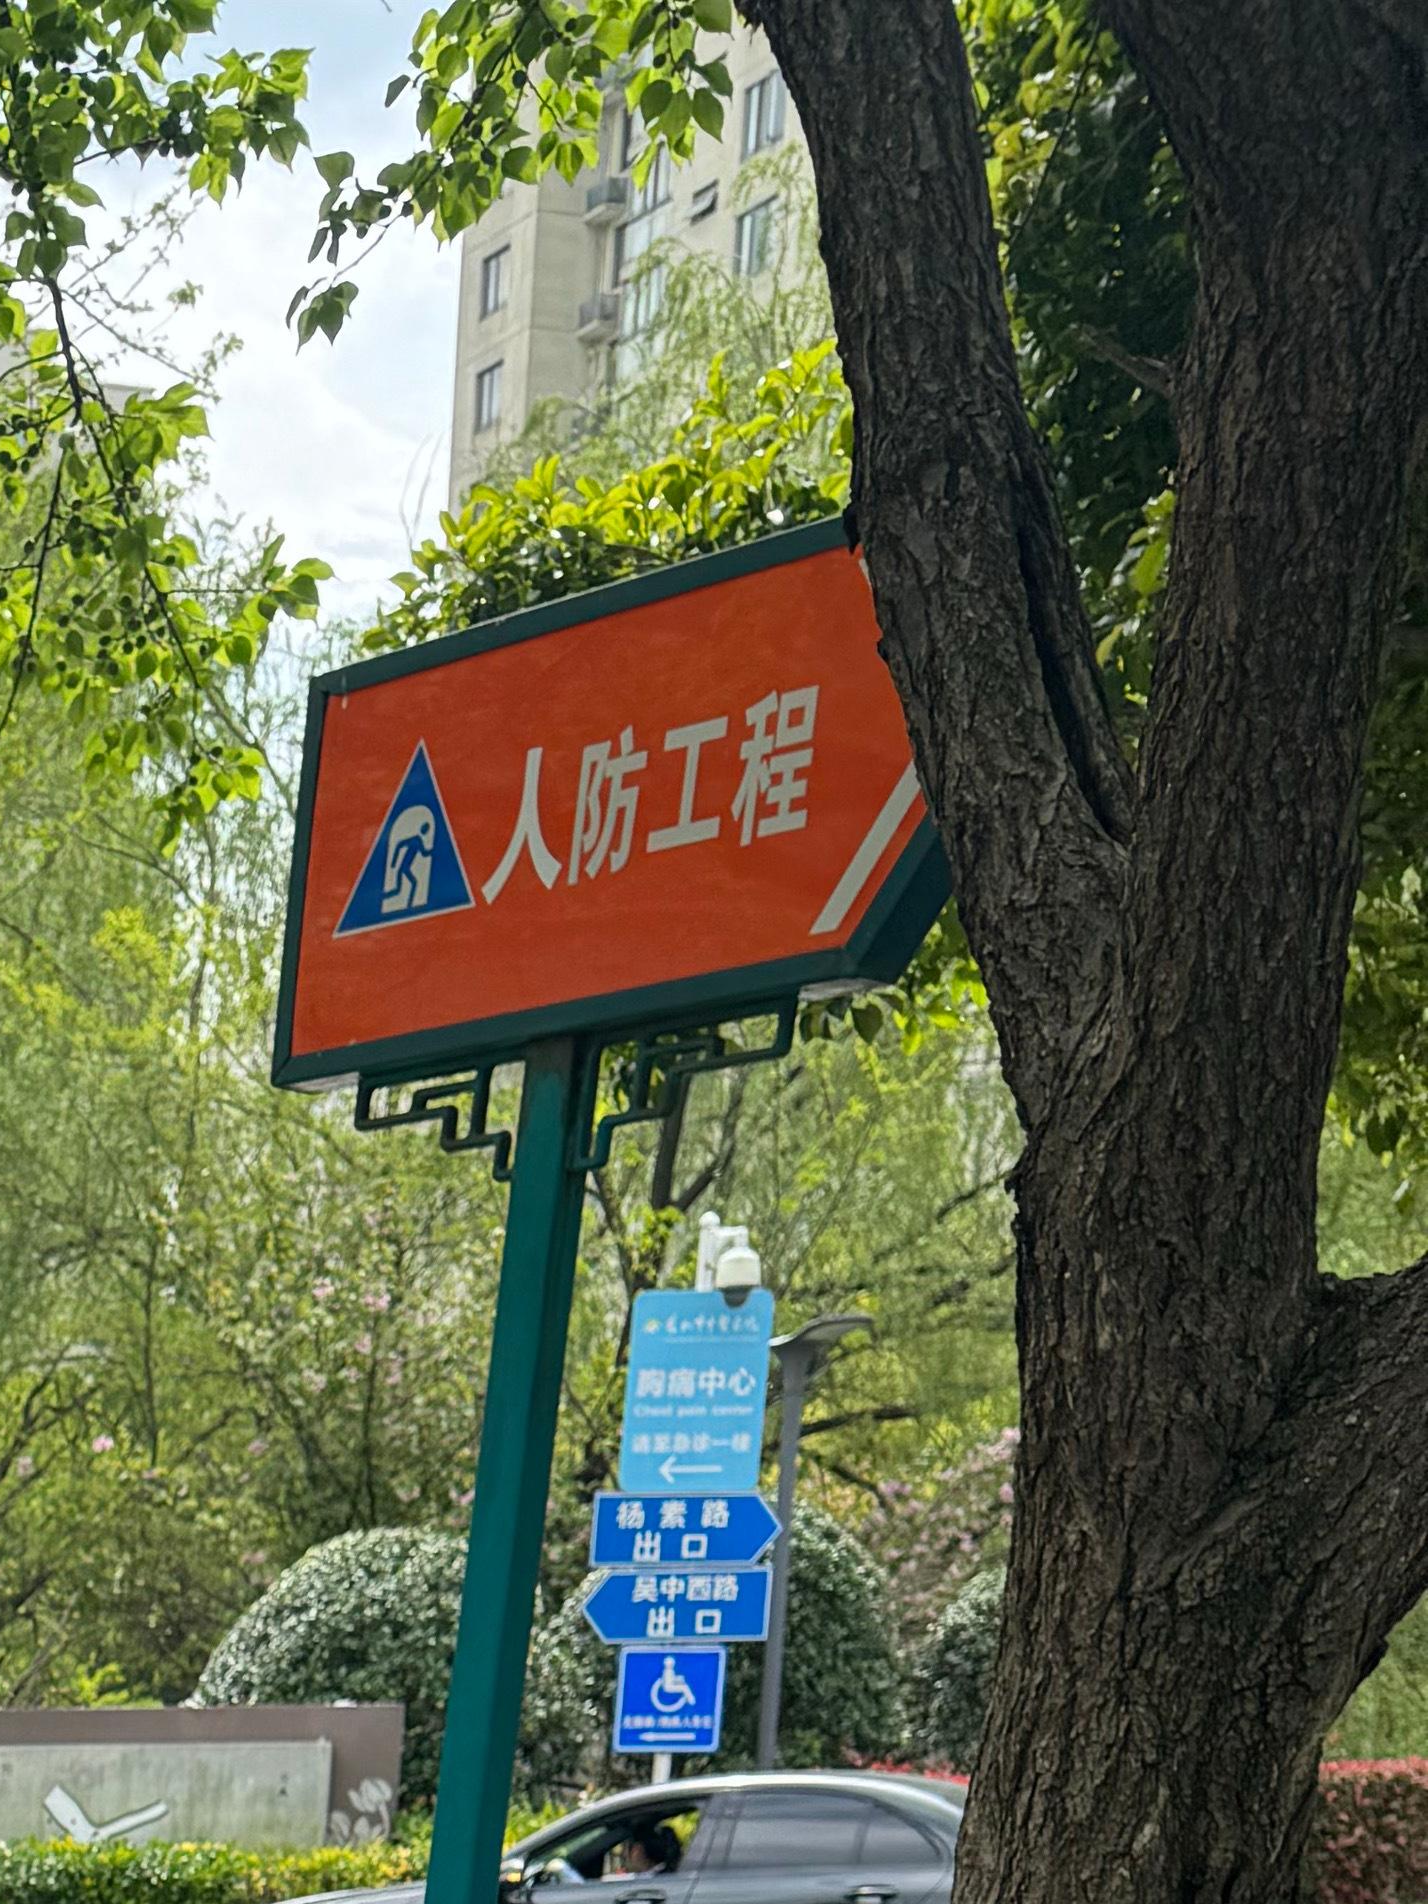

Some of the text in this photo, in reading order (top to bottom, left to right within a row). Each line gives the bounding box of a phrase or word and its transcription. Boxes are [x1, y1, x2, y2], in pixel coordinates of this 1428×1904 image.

[481, 686, 819, 904] 人防工程
[636, 1366, 757, 1398] 胸痛中心
[616, 1499, 730, 1529] 杨素路
[632, 1530, 708, 1562] 出口
[631, 1575, 739, 1603] 吴中西路
[646, 1606, 722, 1638] 出口
